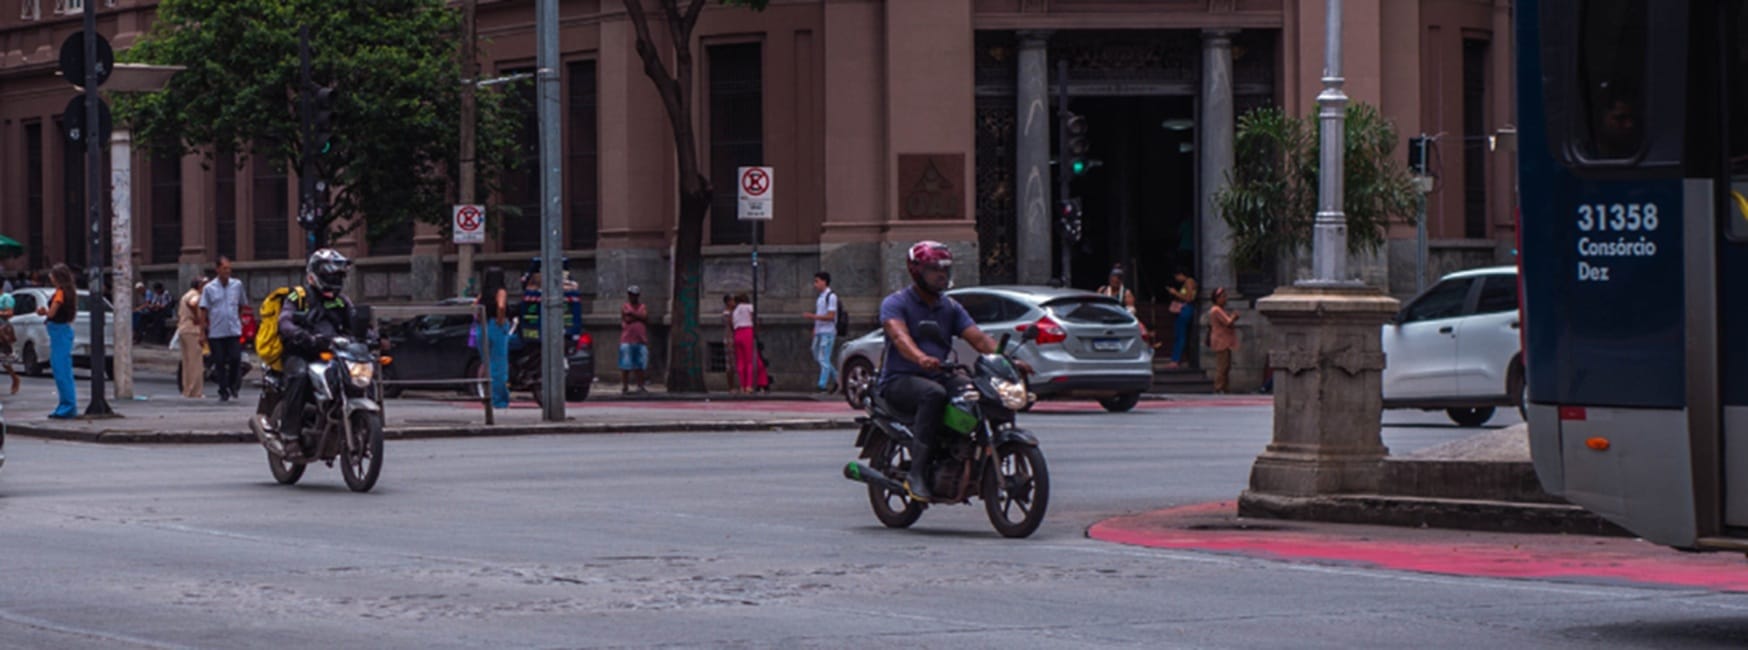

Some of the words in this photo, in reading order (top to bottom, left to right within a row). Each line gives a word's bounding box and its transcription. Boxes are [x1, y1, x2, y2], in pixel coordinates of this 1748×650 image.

[1577, 203, 1659, 231] 31358
[1578, 236, 1657, 257] Consórcio
[1578, 261, 1610, 281] Dez
